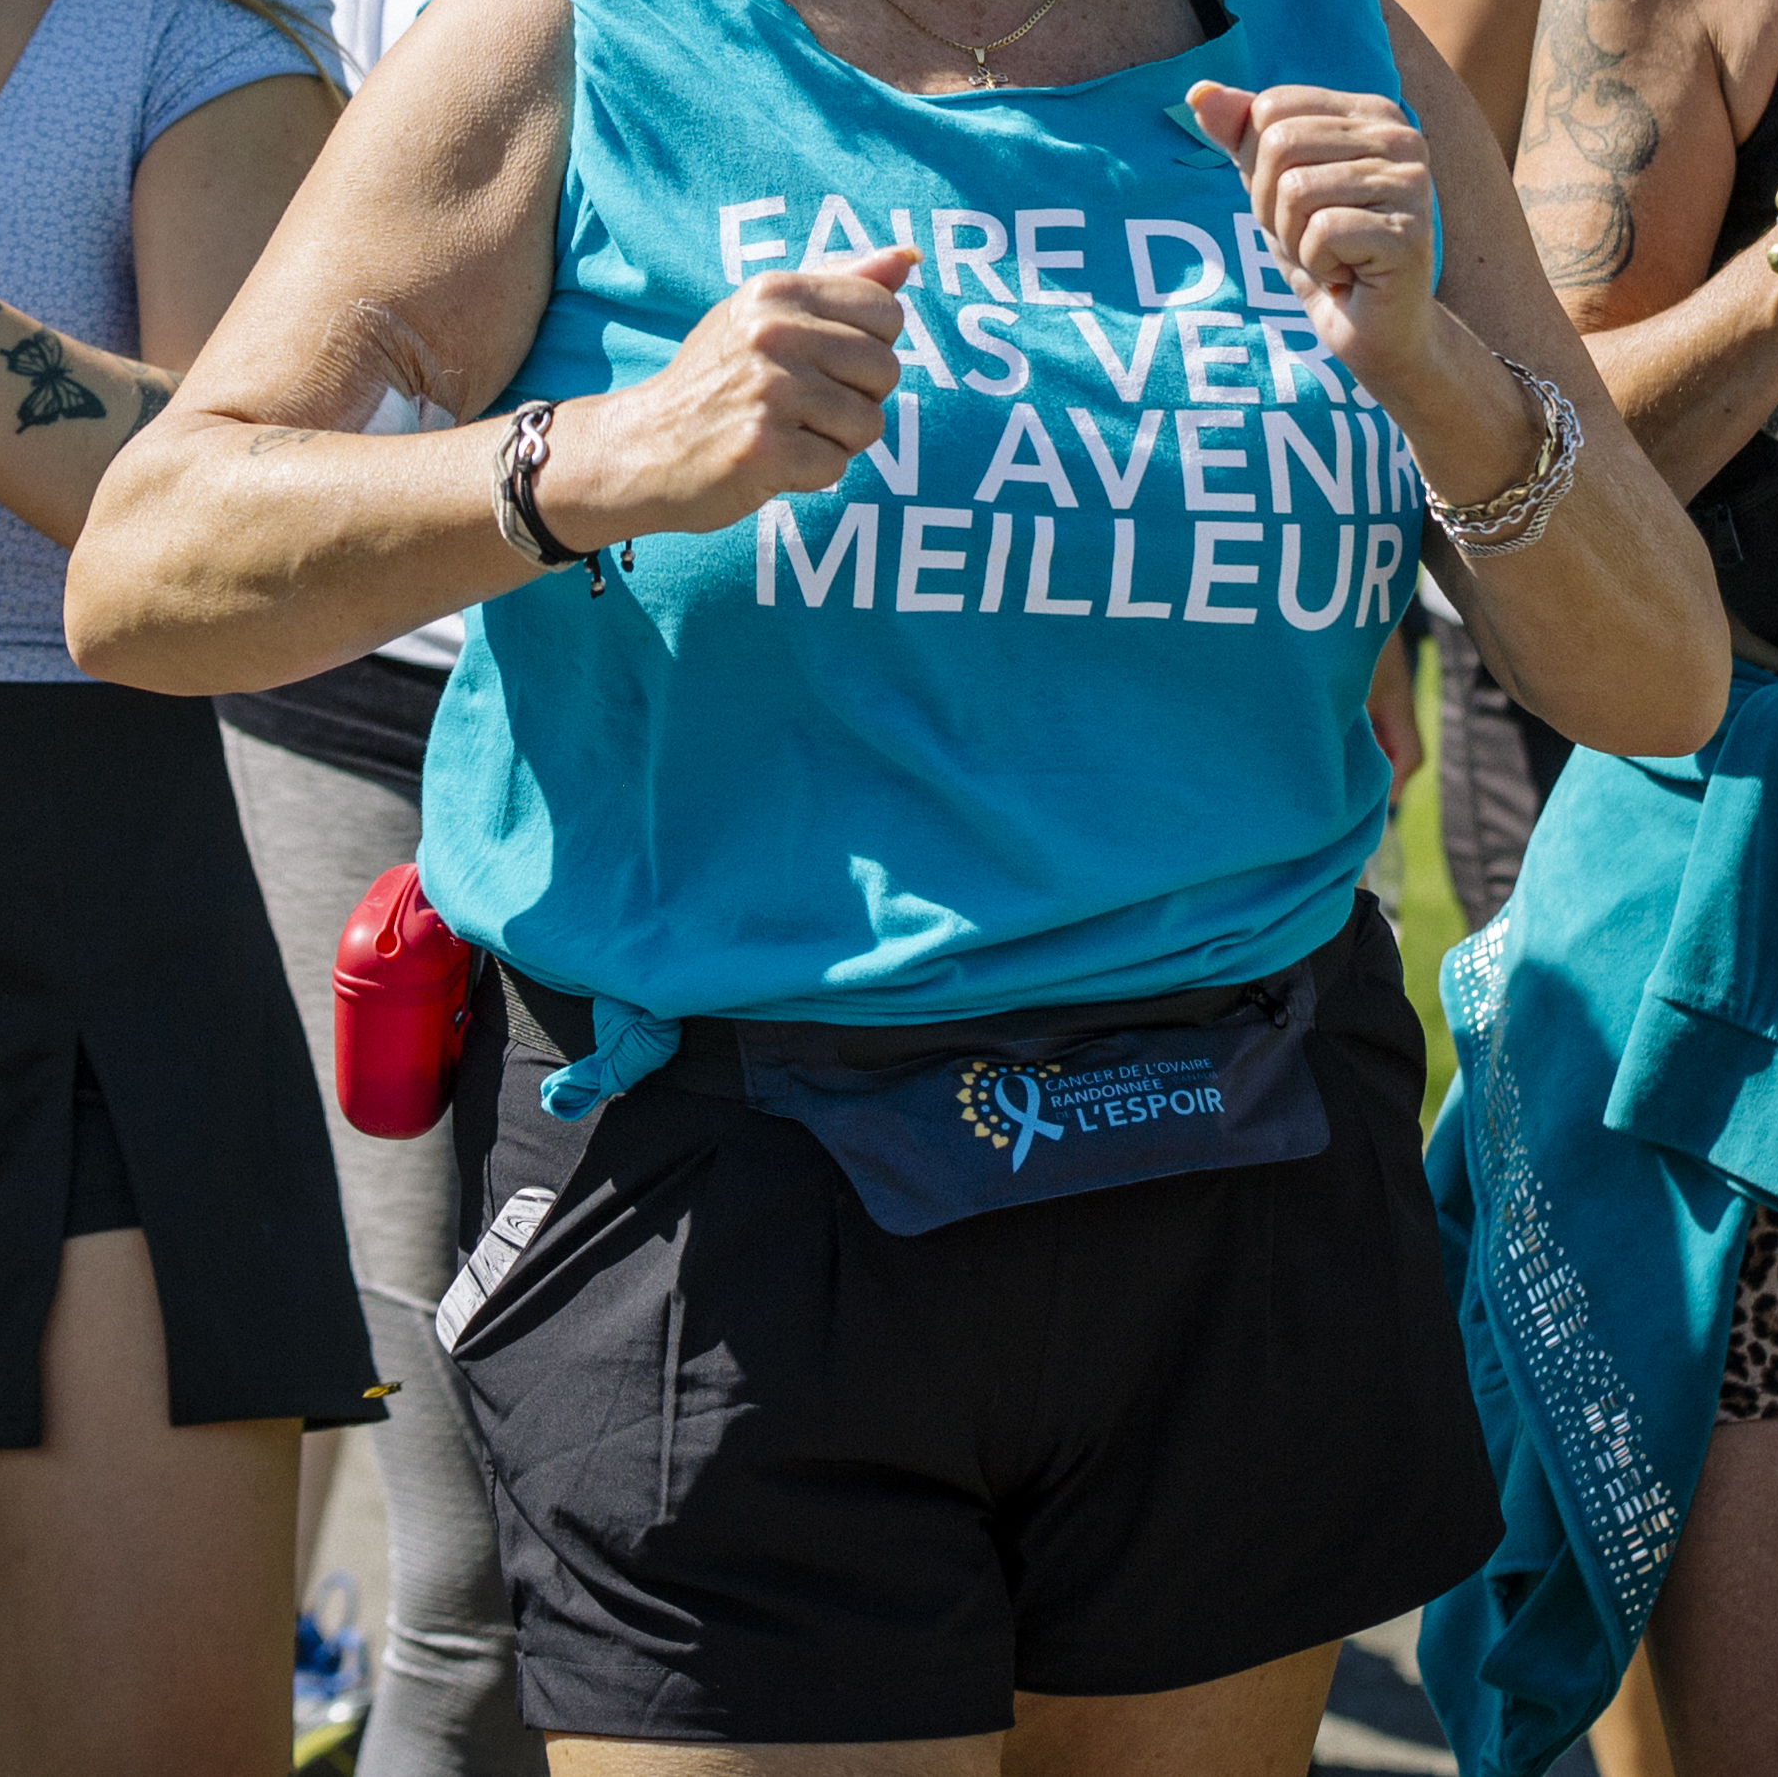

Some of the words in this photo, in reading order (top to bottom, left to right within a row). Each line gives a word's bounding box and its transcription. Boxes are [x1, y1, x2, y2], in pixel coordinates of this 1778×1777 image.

[718, 193, 1093, 308] FAIRE
[1124, 211, 1308, 312] DE
[894, 293, 1030, 398] AS
[1069, 309, 1377, 409] VER
[973, 402, 1419, 515] AVENIR
[756, 498, 1404, 632] MEILLEUR
[1045, 1068, 1115, 1093] CANCER
[1118, 1063, 1142, 1080] DE
[1145, 1057, 1214, 1076] L'OVAIRE
[1050, 1075, 1165, 1109] RANDONNÉE
[1075, 1087, 1226, 1133] L'ESPOIR
